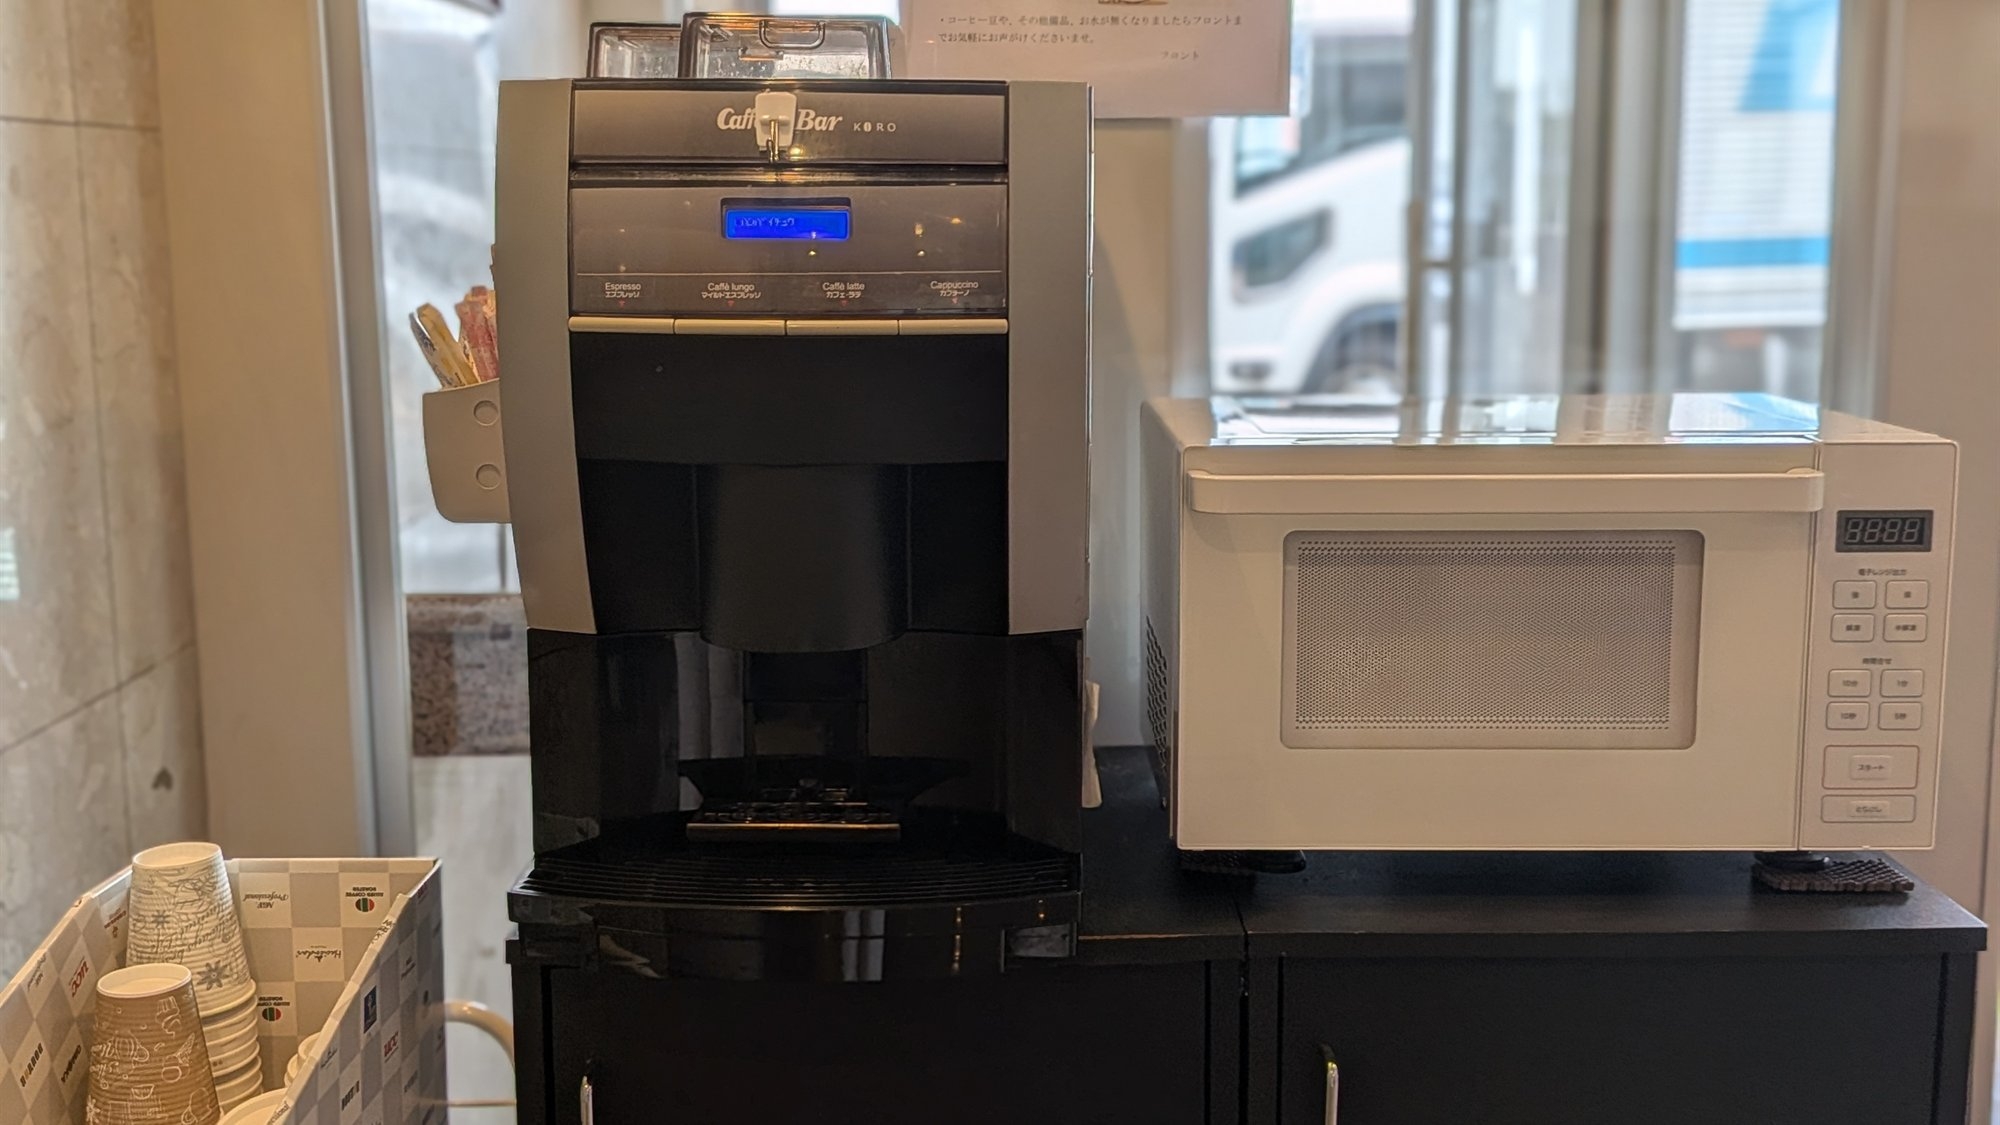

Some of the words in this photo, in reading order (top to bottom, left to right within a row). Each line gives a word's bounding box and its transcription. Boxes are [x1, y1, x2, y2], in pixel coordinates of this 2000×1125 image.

[1161, 51, 1200, 60] フロント
[717, 107, 757, 130] Caff
[796, 109, 843, 131] Bar
[853, 122, 897, 132] KORO
[604, 282, 642, 292] Espresso
[731, 282, 755, 292] lungo
[846, 282, 866, 291] latte
[929, 280, 979, 291] Cappuccino
[71, 960, 89, 998] UCC
